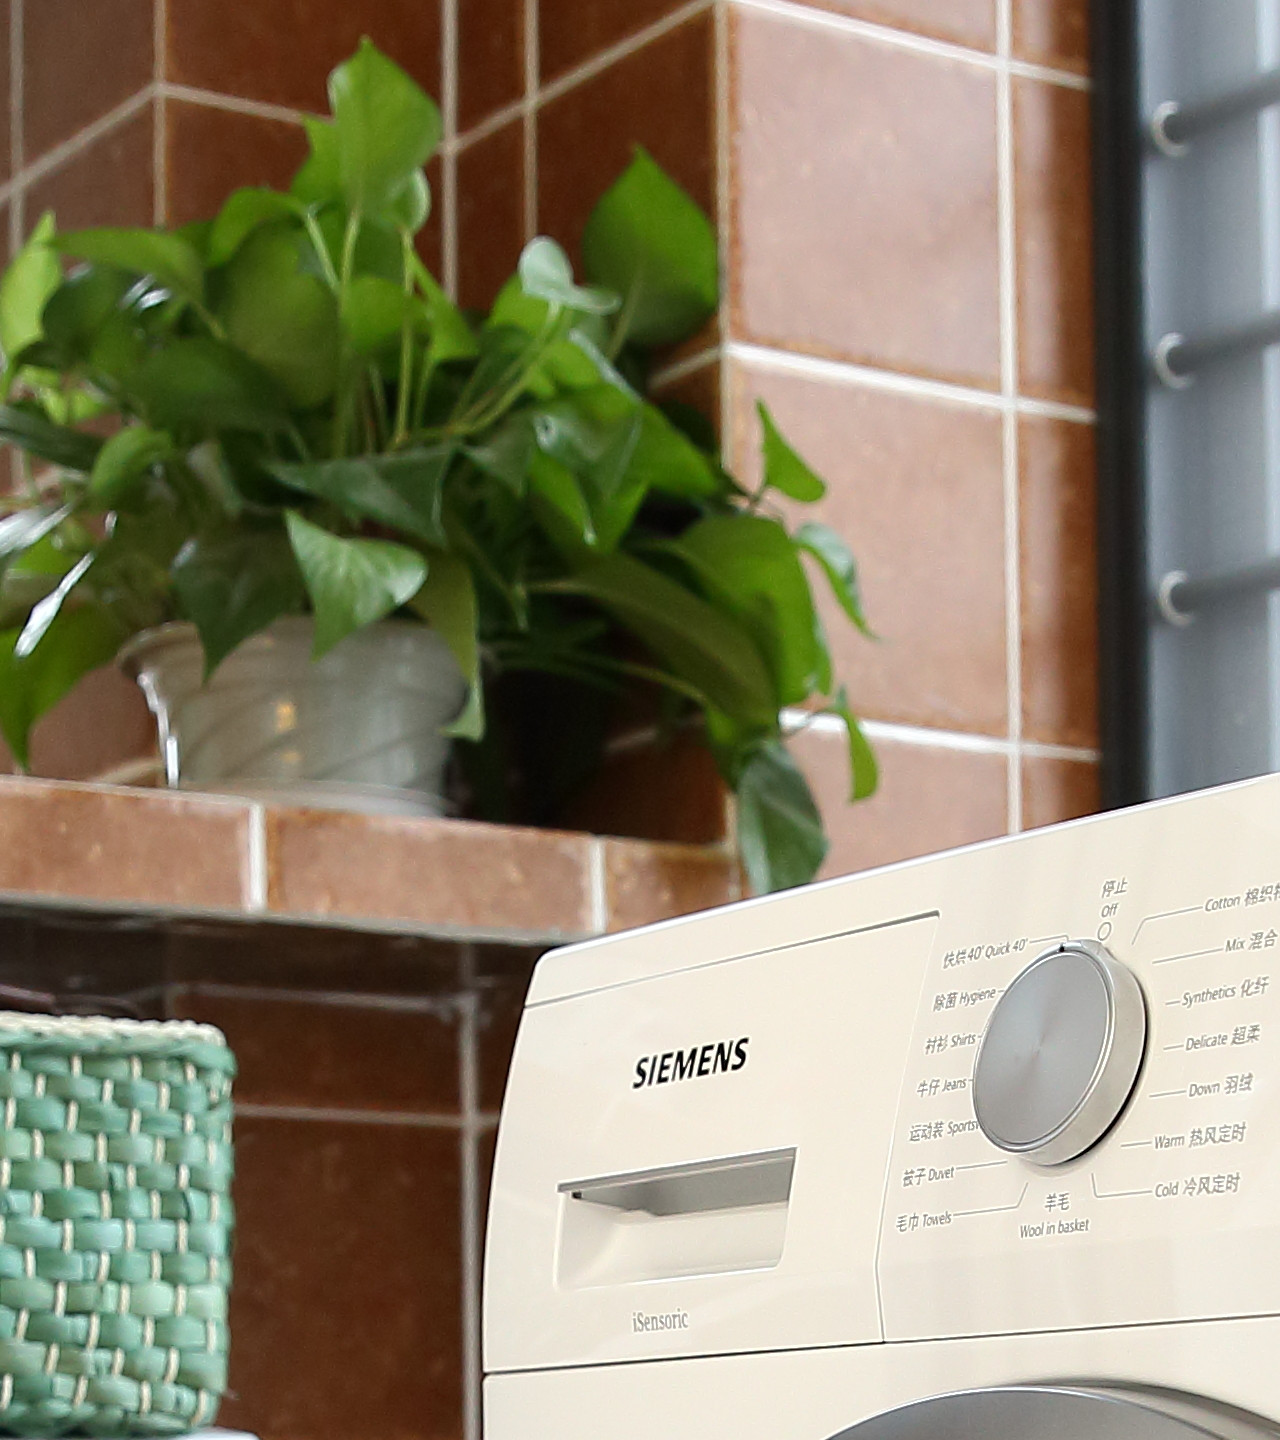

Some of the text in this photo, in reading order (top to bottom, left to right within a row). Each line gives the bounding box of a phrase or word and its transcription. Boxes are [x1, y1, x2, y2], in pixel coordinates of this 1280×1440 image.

[1102, 878, 1128, 898] 停止
[1101, 903, 1119, 918] Off
[1205, 896, 1240, 912] Cotton
[985, 943, 1010, 958] Quick
[1225, 929, 1278, 952] Mix 混合
[933, 989, 996, 1012] 除菌 Hygiene
[1182, 977, 1269, 1008] Synthetics 化纤
[925, 1033, 976, 1055] 衬衫 Shirts
[1186, 1025, 1261, 1050] Delicate 超柔
[632, 1037, 749, 1089] SIEMENS
[917, 1078, 966, 1097] 牛仔 Jeans
[1189, 1073, 1253, 1097] Down 羽绒
[909, 1121, 945, 1142] 运动装
[1154, 1122, 1246, 1149] Warm 热风定时
[928, 1167, 954, 1181] Duvet
[1155, 1172, 1240, 1197] Cold 冷风定时
[1045, 1193, 1069, 1212] 羊毛
[896, 1211, 951, 1232] 毛巾 Towels
[1020, 1219, 1089, 1238] Wool in basket
[633, 1308, 688, 1332] iSensoric
